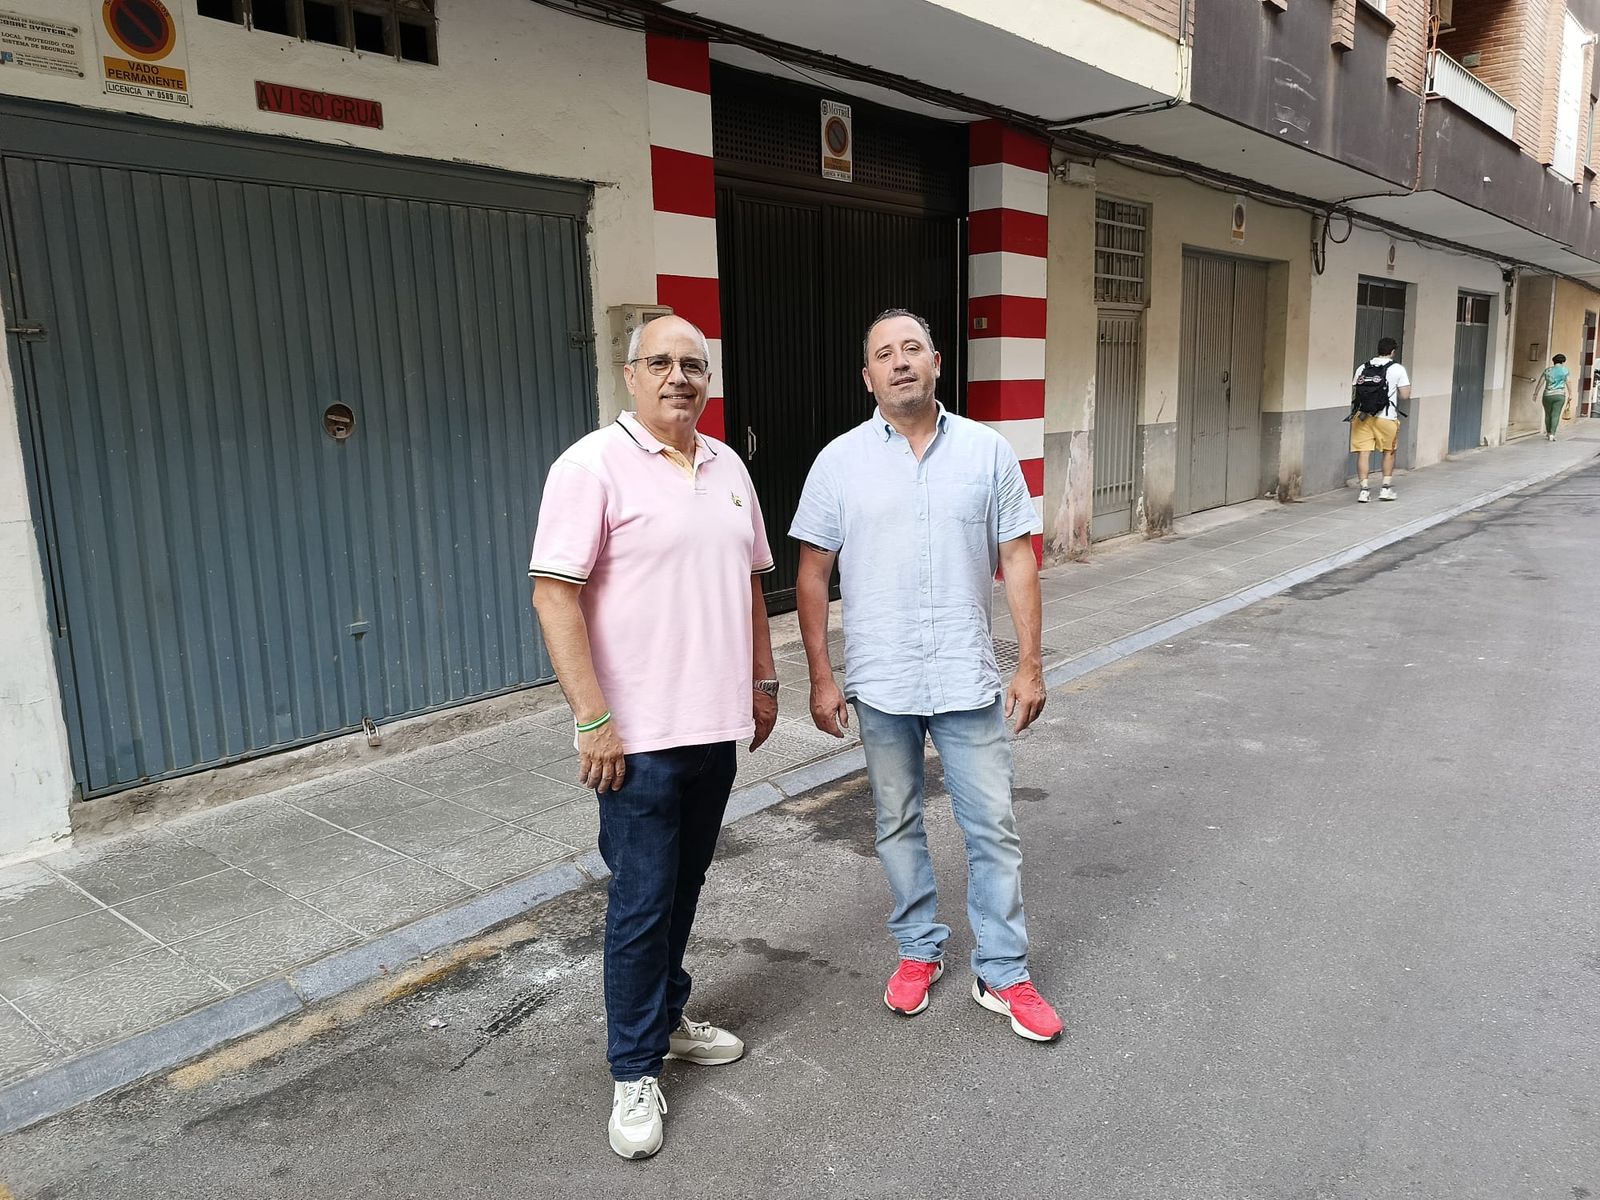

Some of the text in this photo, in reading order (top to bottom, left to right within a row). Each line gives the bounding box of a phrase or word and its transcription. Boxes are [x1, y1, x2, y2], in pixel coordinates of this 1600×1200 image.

[1, 31, 22, 39] LOCAL
[24, 36, 60, 46] PROTEGIDO
[2, 38, 30, 47] SISTEMA
[41, 45, 75, 55] SEGURIDAD
[127, 61, 160, 75] VADO
[108, 68, 183, 90] PERMANENTE
[108, 83, 142, 95] LICENCIA
[258, 83, 380, 125] AVISO GRUA
